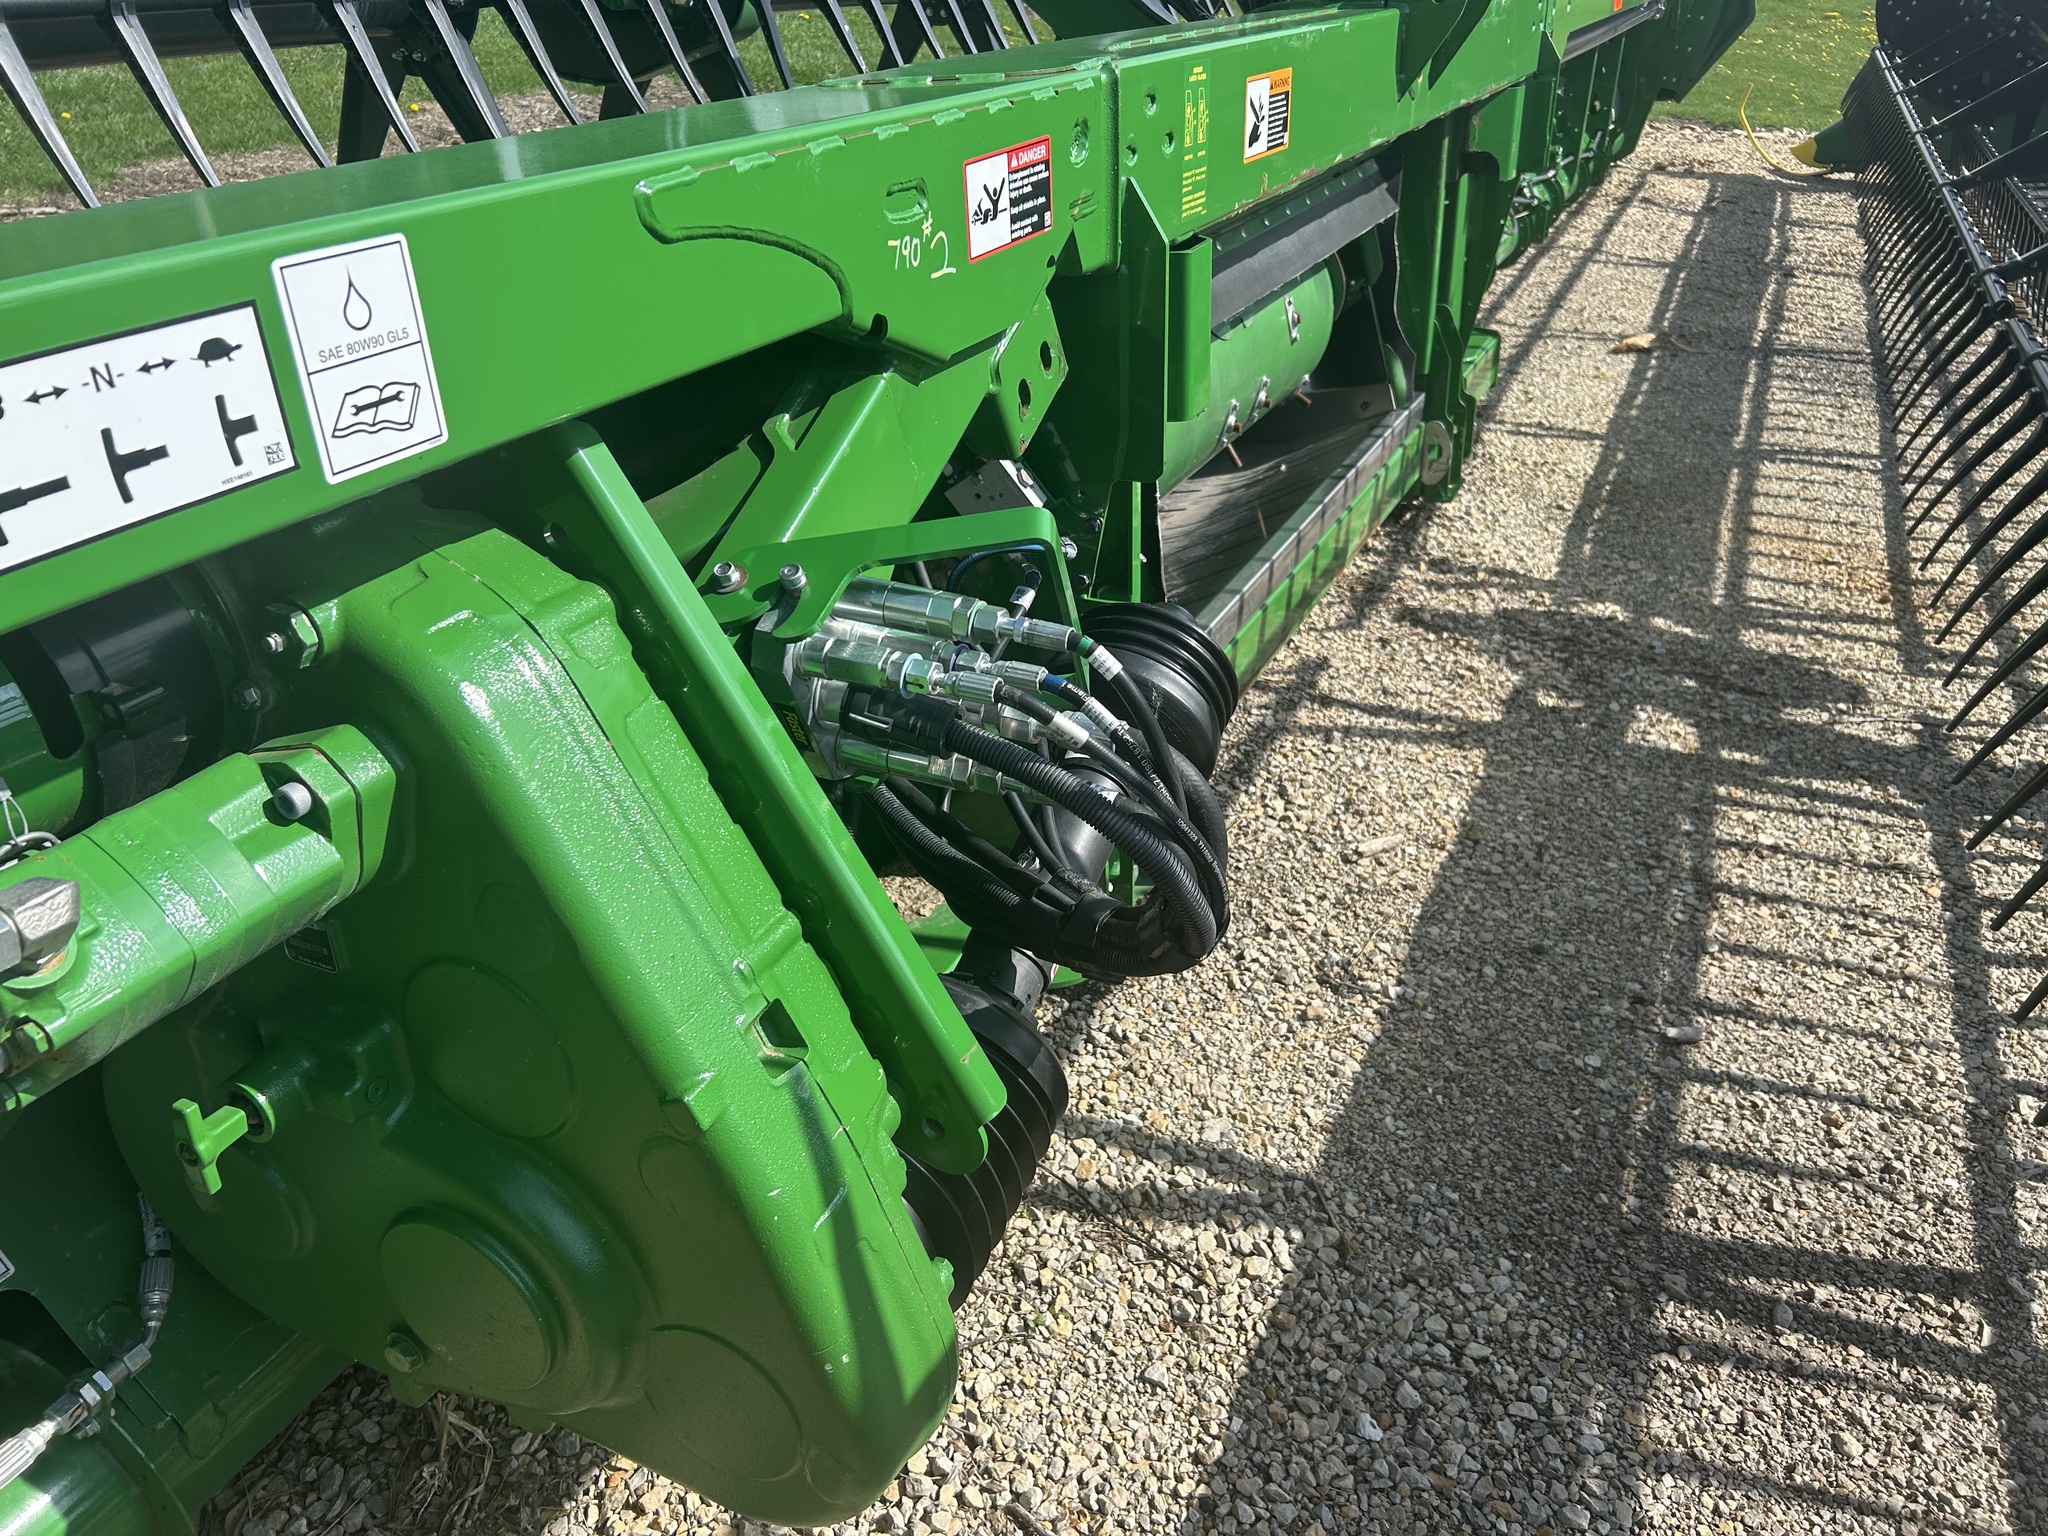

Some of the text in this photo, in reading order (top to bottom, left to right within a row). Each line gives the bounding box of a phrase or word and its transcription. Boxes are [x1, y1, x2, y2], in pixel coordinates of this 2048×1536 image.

[1273, 76, 1290, 90] WARNING
[1018, 145, 1046, 164] DANGER
[887, 235, 920, 270] 790
[318, 327, 410, 364] SAE 80W90 GL5
[1122, 735, 1147, 763] 18752
